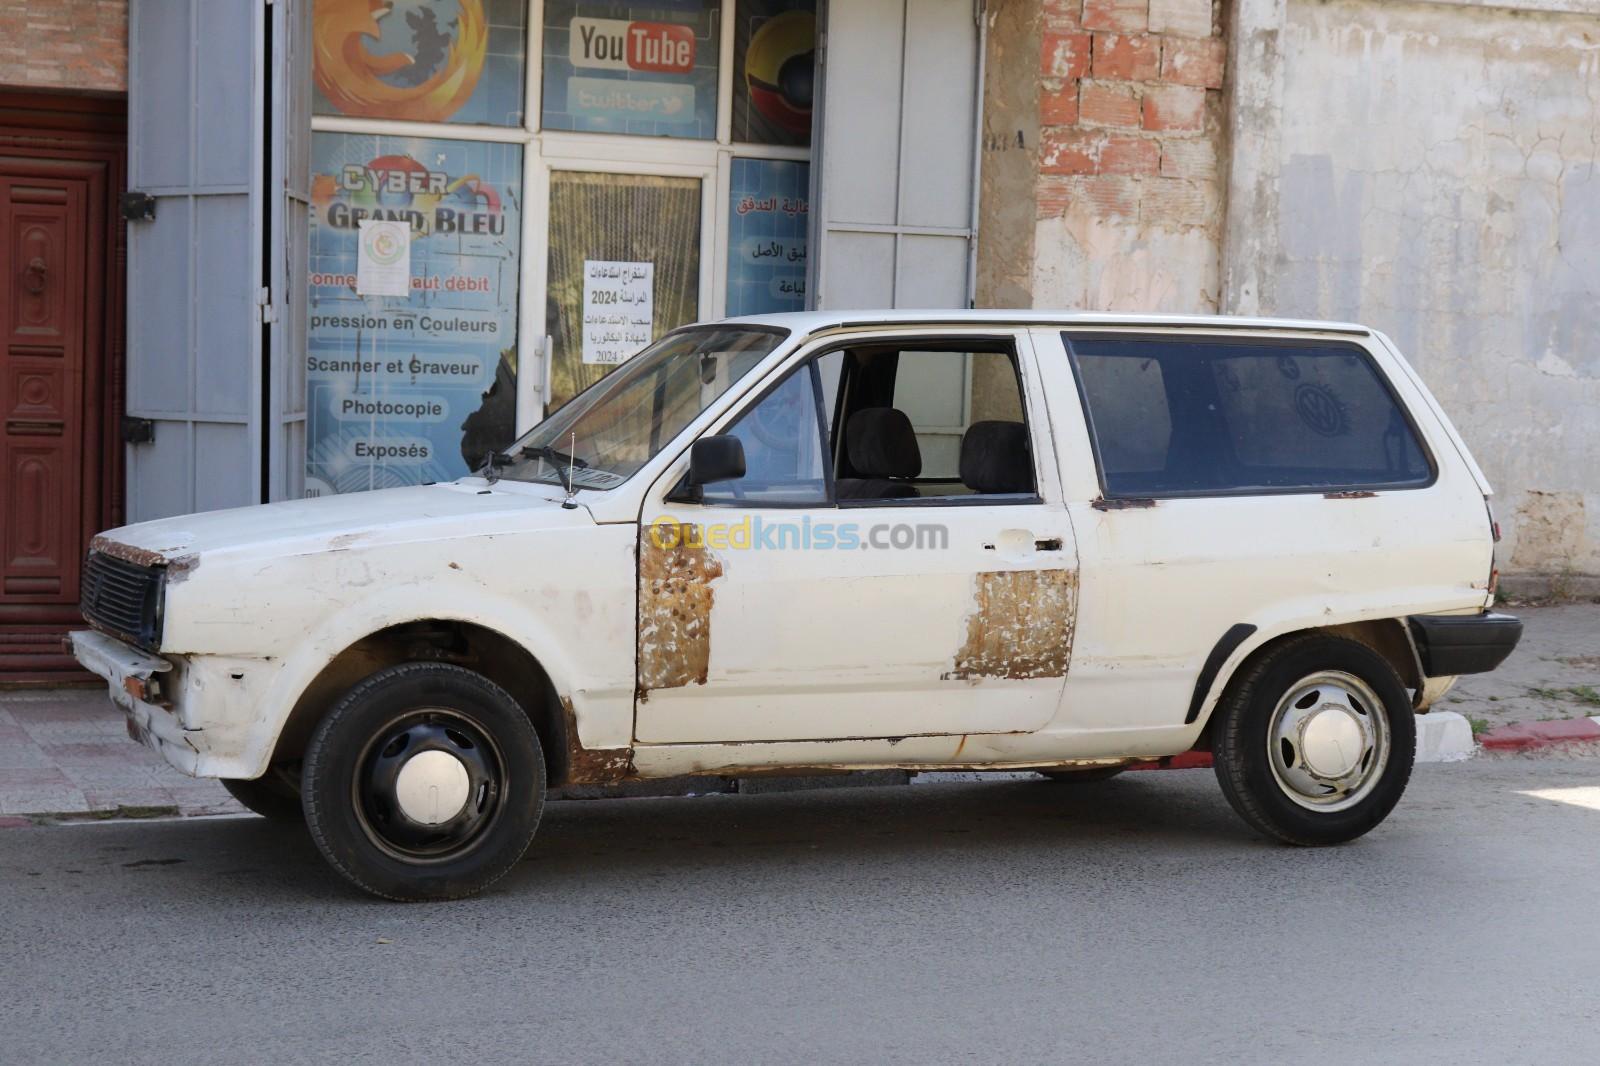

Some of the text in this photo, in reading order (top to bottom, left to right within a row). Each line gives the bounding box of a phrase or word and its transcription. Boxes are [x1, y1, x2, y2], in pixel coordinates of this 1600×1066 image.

[580, 24, 691, 67] YouTube
[342, 163, 449, 194] CYBER
[434, 206, 506, 236] BLEU
[445, 276, 489, 292] débit
[591, 290, 618, 305] 2024
[393, 317, 414, 331] en
[419, 316, 498, 333] Couleurs
[595, 350, 618, 362] 2024
[307, 357, 480, 375] Scanner et Graveur
[342, 399, 442, 418] Photocopie
[355, 442, 429, 459] Exposés
